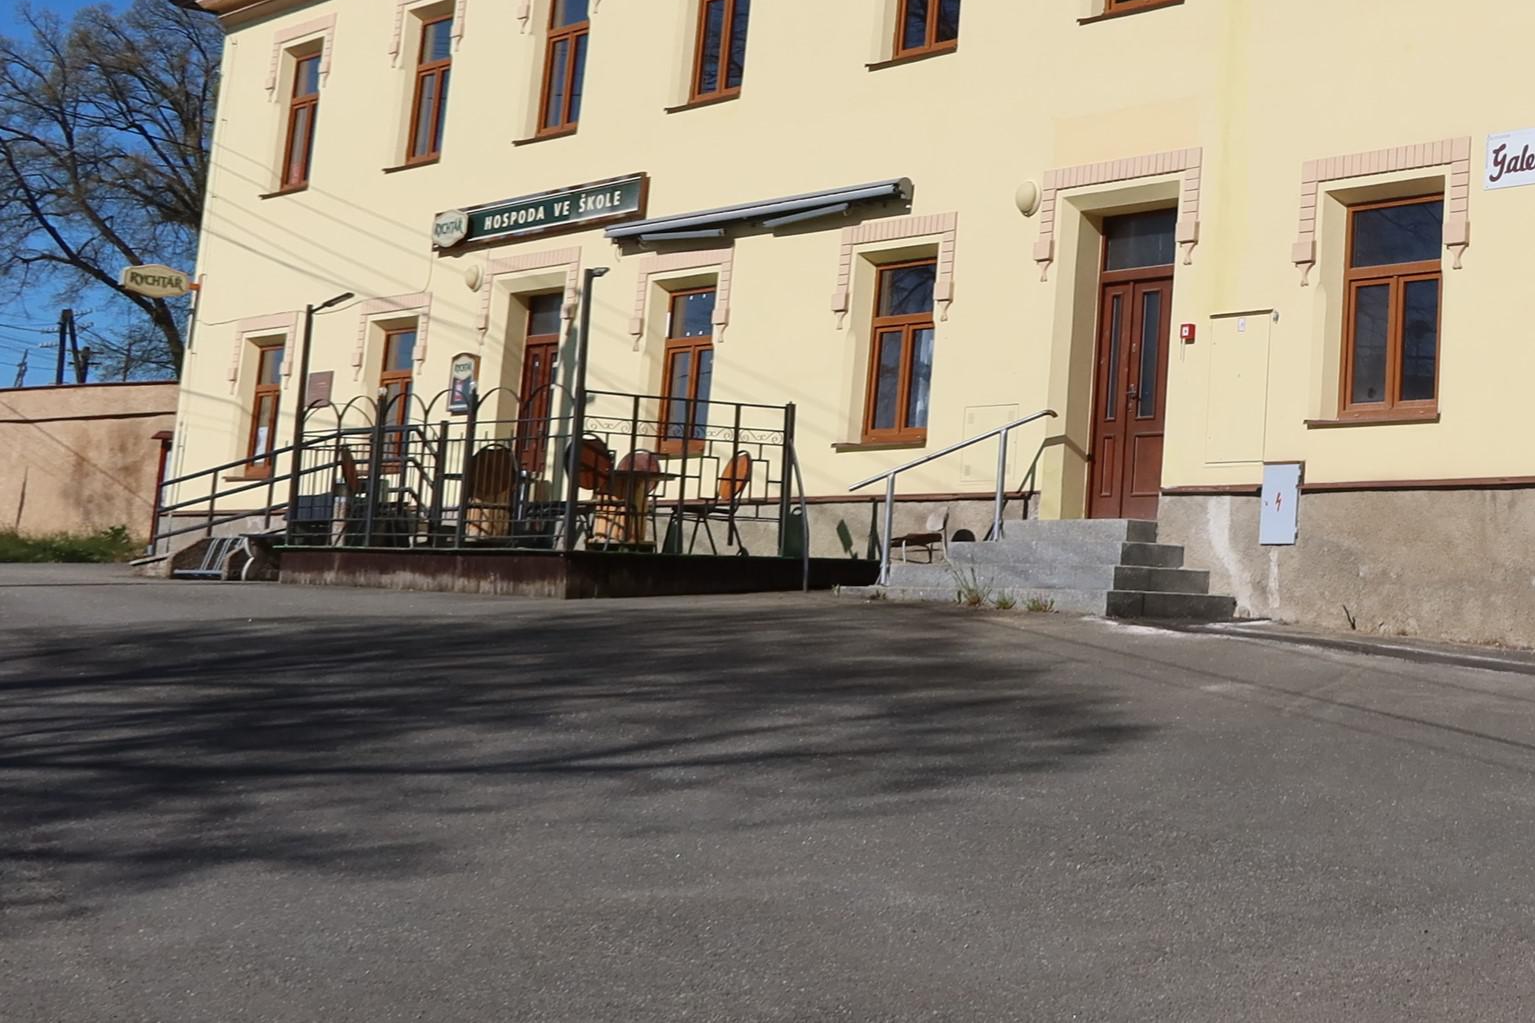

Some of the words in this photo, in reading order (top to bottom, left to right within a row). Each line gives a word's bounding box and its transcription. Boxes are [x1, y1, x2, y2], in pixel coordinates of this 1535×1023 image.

[484, 206, 545, 231] HOSPODA
[553, 201, 571, 217] VE
[578, 191, 622, 213] ŠKOLE
